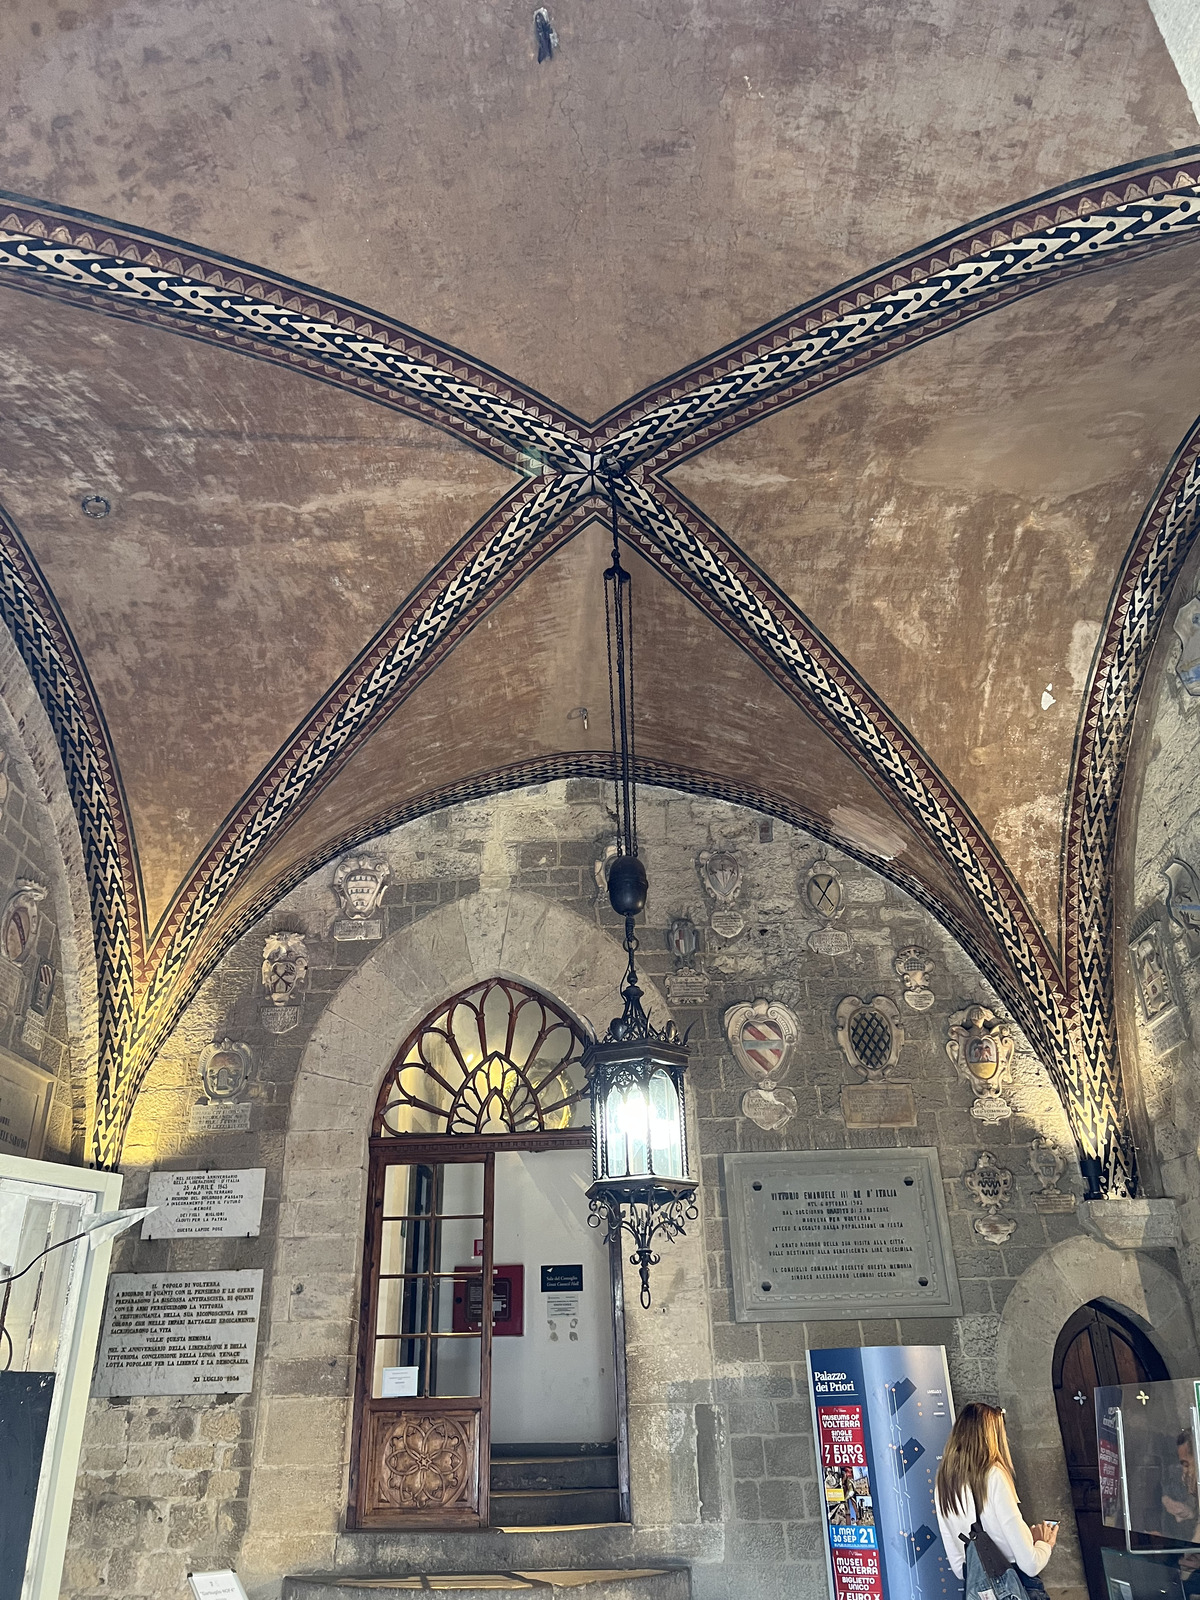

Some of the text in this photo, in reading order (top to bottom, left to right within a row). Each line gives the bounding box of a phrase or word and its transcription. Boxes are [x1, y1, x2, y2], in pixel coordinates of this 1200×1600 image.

[771, 1192, 799, 1200] VITTORIO
[804, 1191, 835, 1199] EMANUELE
[814, 1371, 846, 1381] Palazzo
[816, 1381, 855, 1392] dei Priori
[825, 1444, 862, 1454] 7 EURO
[825, 1454, 864, 1464] 7 DAYS
[859, 1528, 874, 1543] 21
[837, 1558, 863, 1566] MUSEI
[837, 1566, 878, 1575] VOLTERRA
